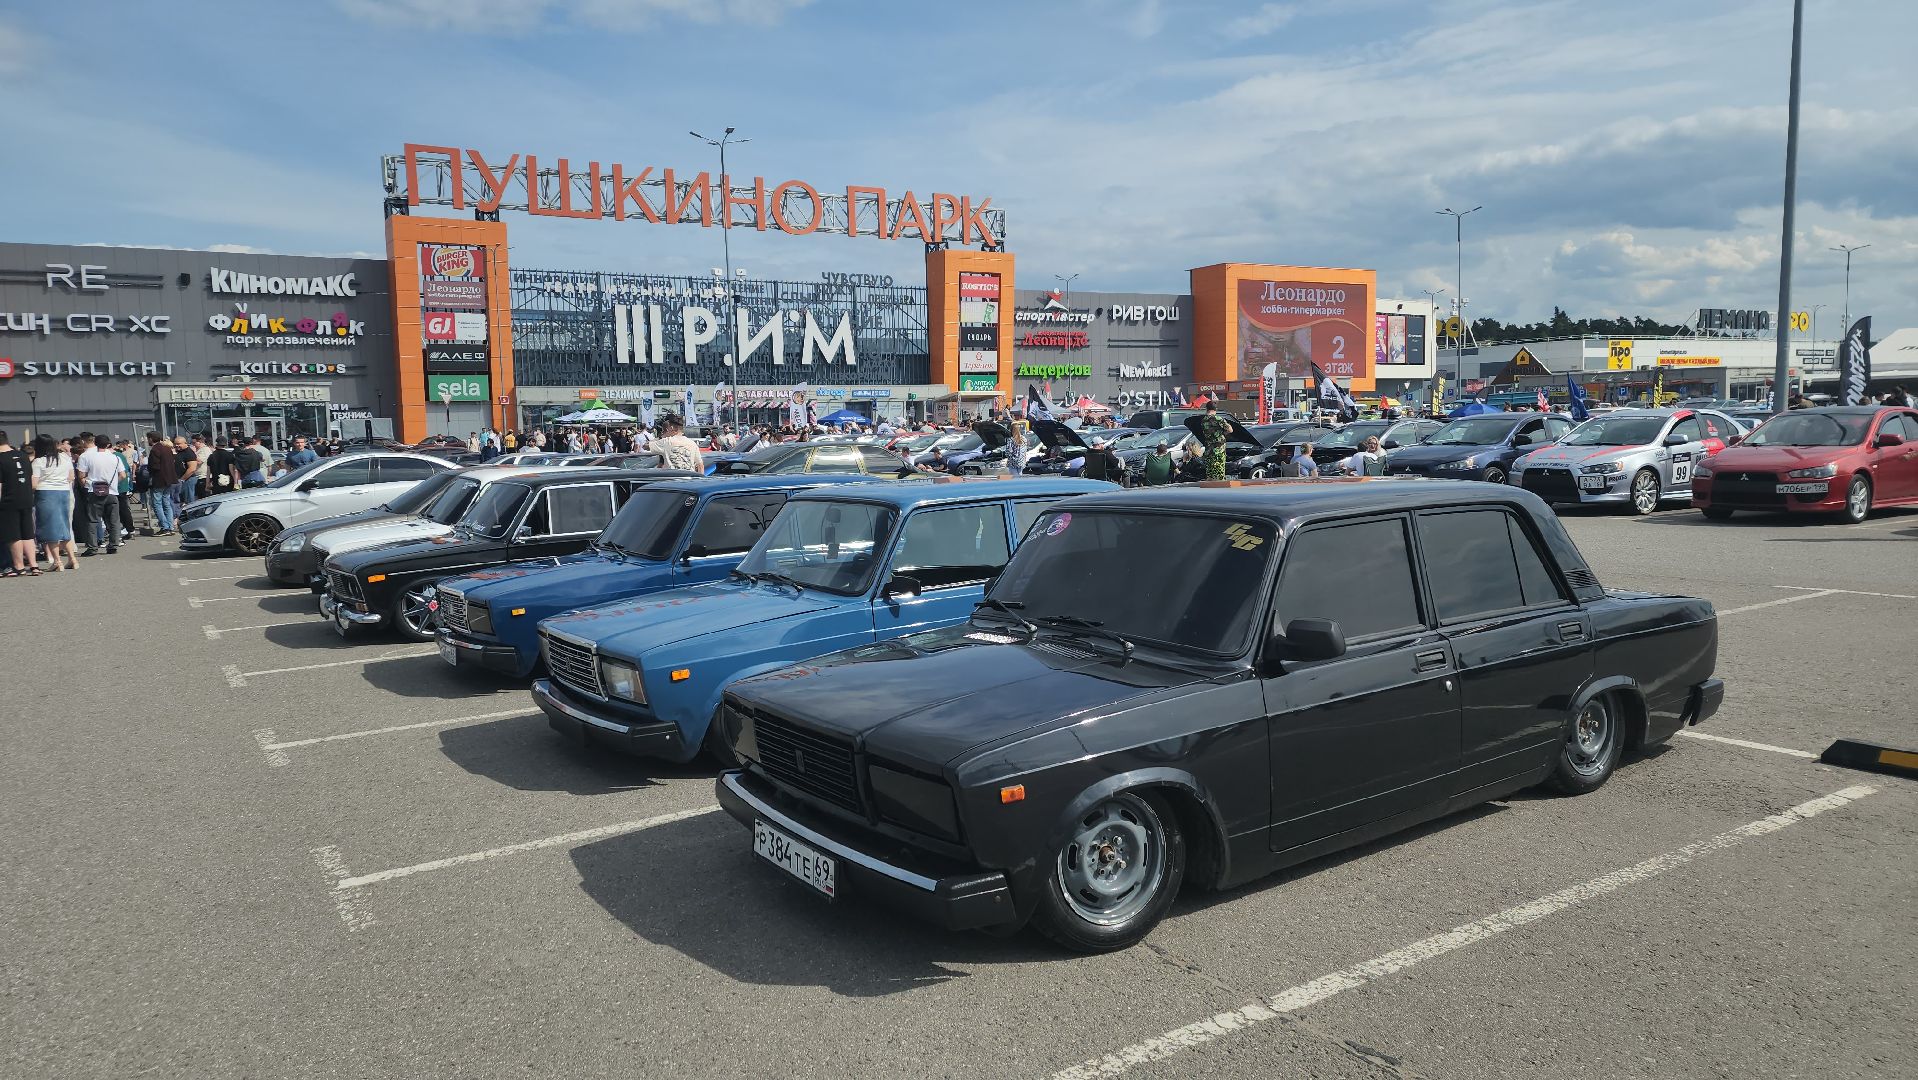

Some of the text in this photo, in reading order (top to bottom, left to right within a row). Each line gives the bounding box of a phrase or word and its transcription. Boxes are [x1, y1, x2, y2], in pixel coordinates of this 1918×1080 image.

[404, 143, 997, 247] ПУШКИНО ПАРК
[437, 251, 468, 264] BURGER
[438, 258, 469, 273] KING
[46, 263, 109, 290] RE
[211, 267, 357, 297] КИНОМАКС
[822, 271, 894, 286] ЧУВСТВУЮ
[427, 283, 481, 294] Леонардо
[544, 281, 598, 294] ТЕАТР
[962, 282, 999, 291] ROSTIC'S
[1261, 282, 1346, 306] Леонардо
[1015, 311, 1095, 323] спортмастер
[1112, 304, 1180, 321] РИВ ГОШ
[1261, 304, 1346, 316] хобби-гипермаркет
[1697, 308, 1809, 333] ЛЕМАНА РО
[226, 335, 356, 347] парк развлечений
[967, 333, 992, 341] СУДАРЬ
[1022, 331, 1089, 349] Леонардо
[1332, 335, 1345, 359] 2
[1611, 346, 1631, 357] ПРО
[24, 361, 176, 376] SUNLIGHT
[240, 360, 280, 374] kari
[1018, 362, 1092, 379] Андерсон
[1324, 363, 1354, 374] этаж
[169, 386, 324, 401] ГРИЛЬ ЦЕНТР
[438, 379, 480, 396] sela
[332, 412, 373, 420] ТЕХНИКА
[1675, 465, 1687, 481] 99
[814, 856, 829, 881] 69
